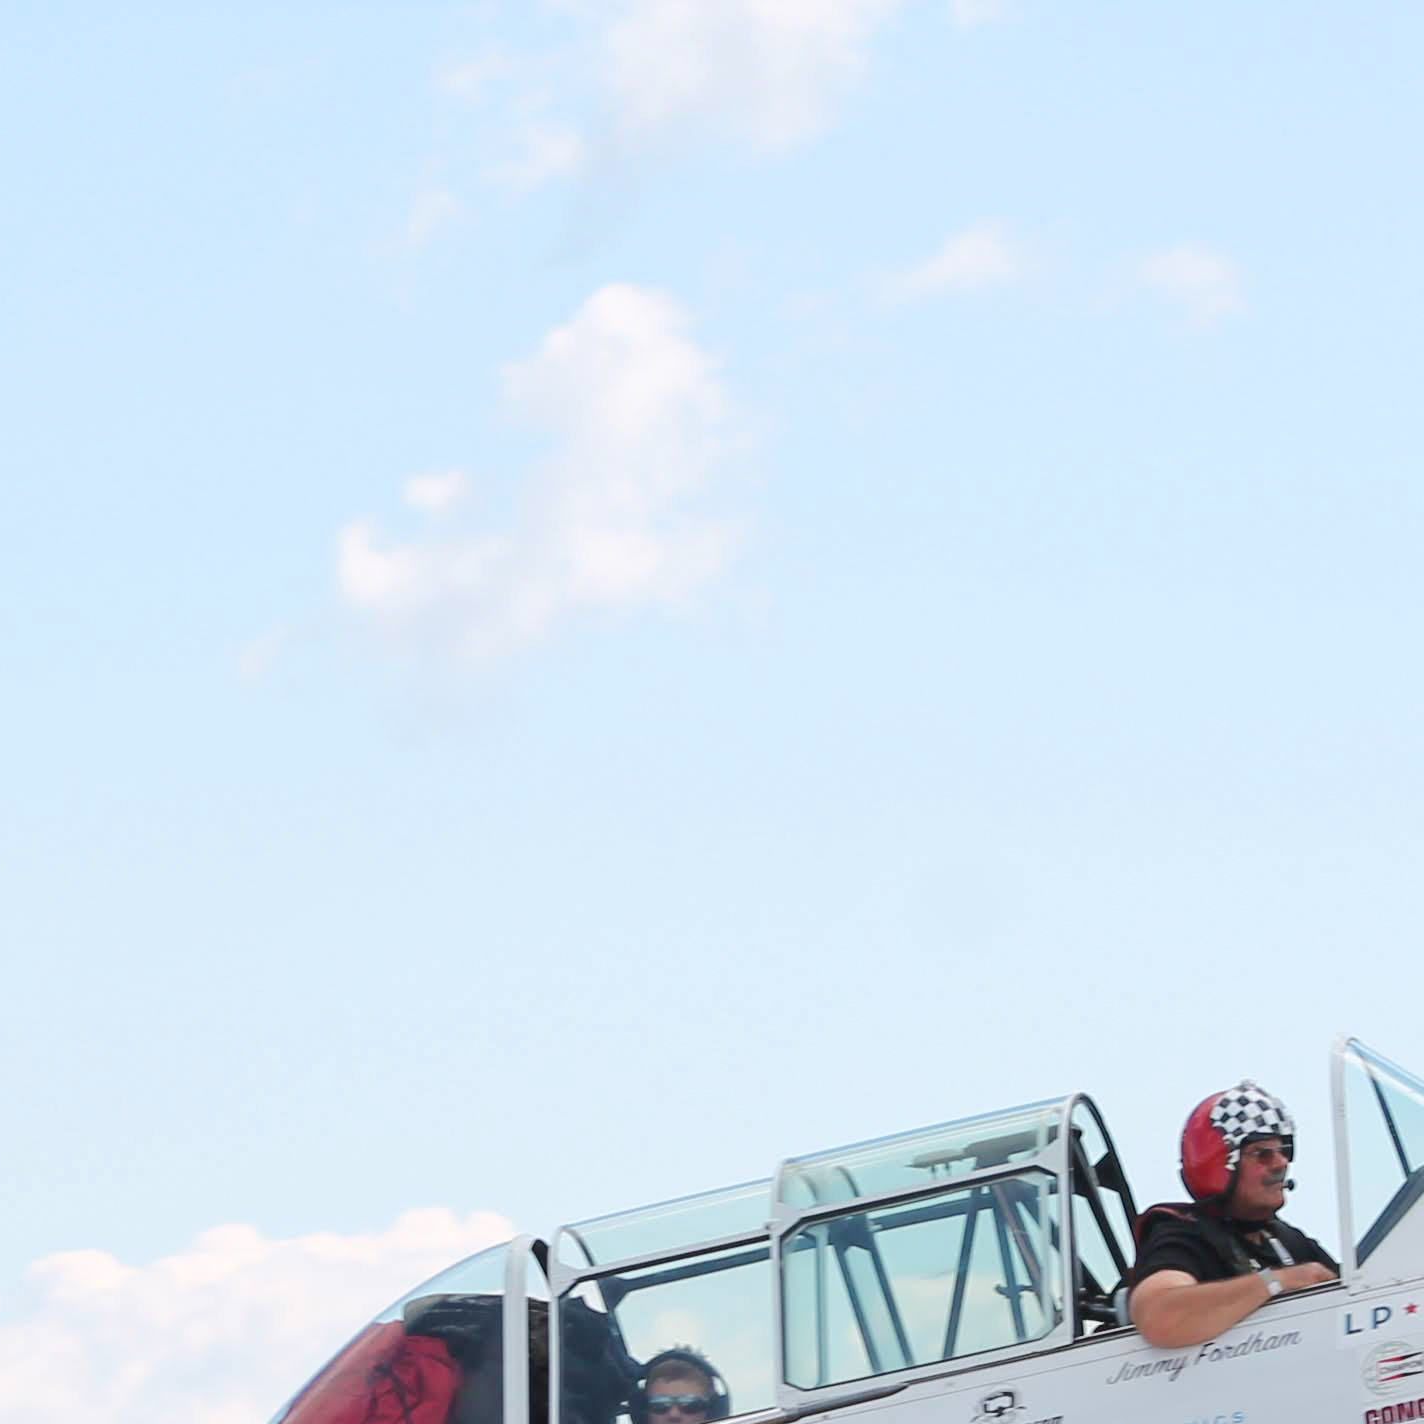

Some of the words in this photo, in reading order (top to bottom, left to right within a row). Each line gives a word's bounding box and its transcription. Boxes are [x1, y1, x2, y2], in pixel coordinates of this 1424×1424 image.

[1344, 1306, 1392, 1336] LP
[1106, 1354, 1190, 1385] Jimmy
[1193, 1330, 1303, 1366] Fordham
